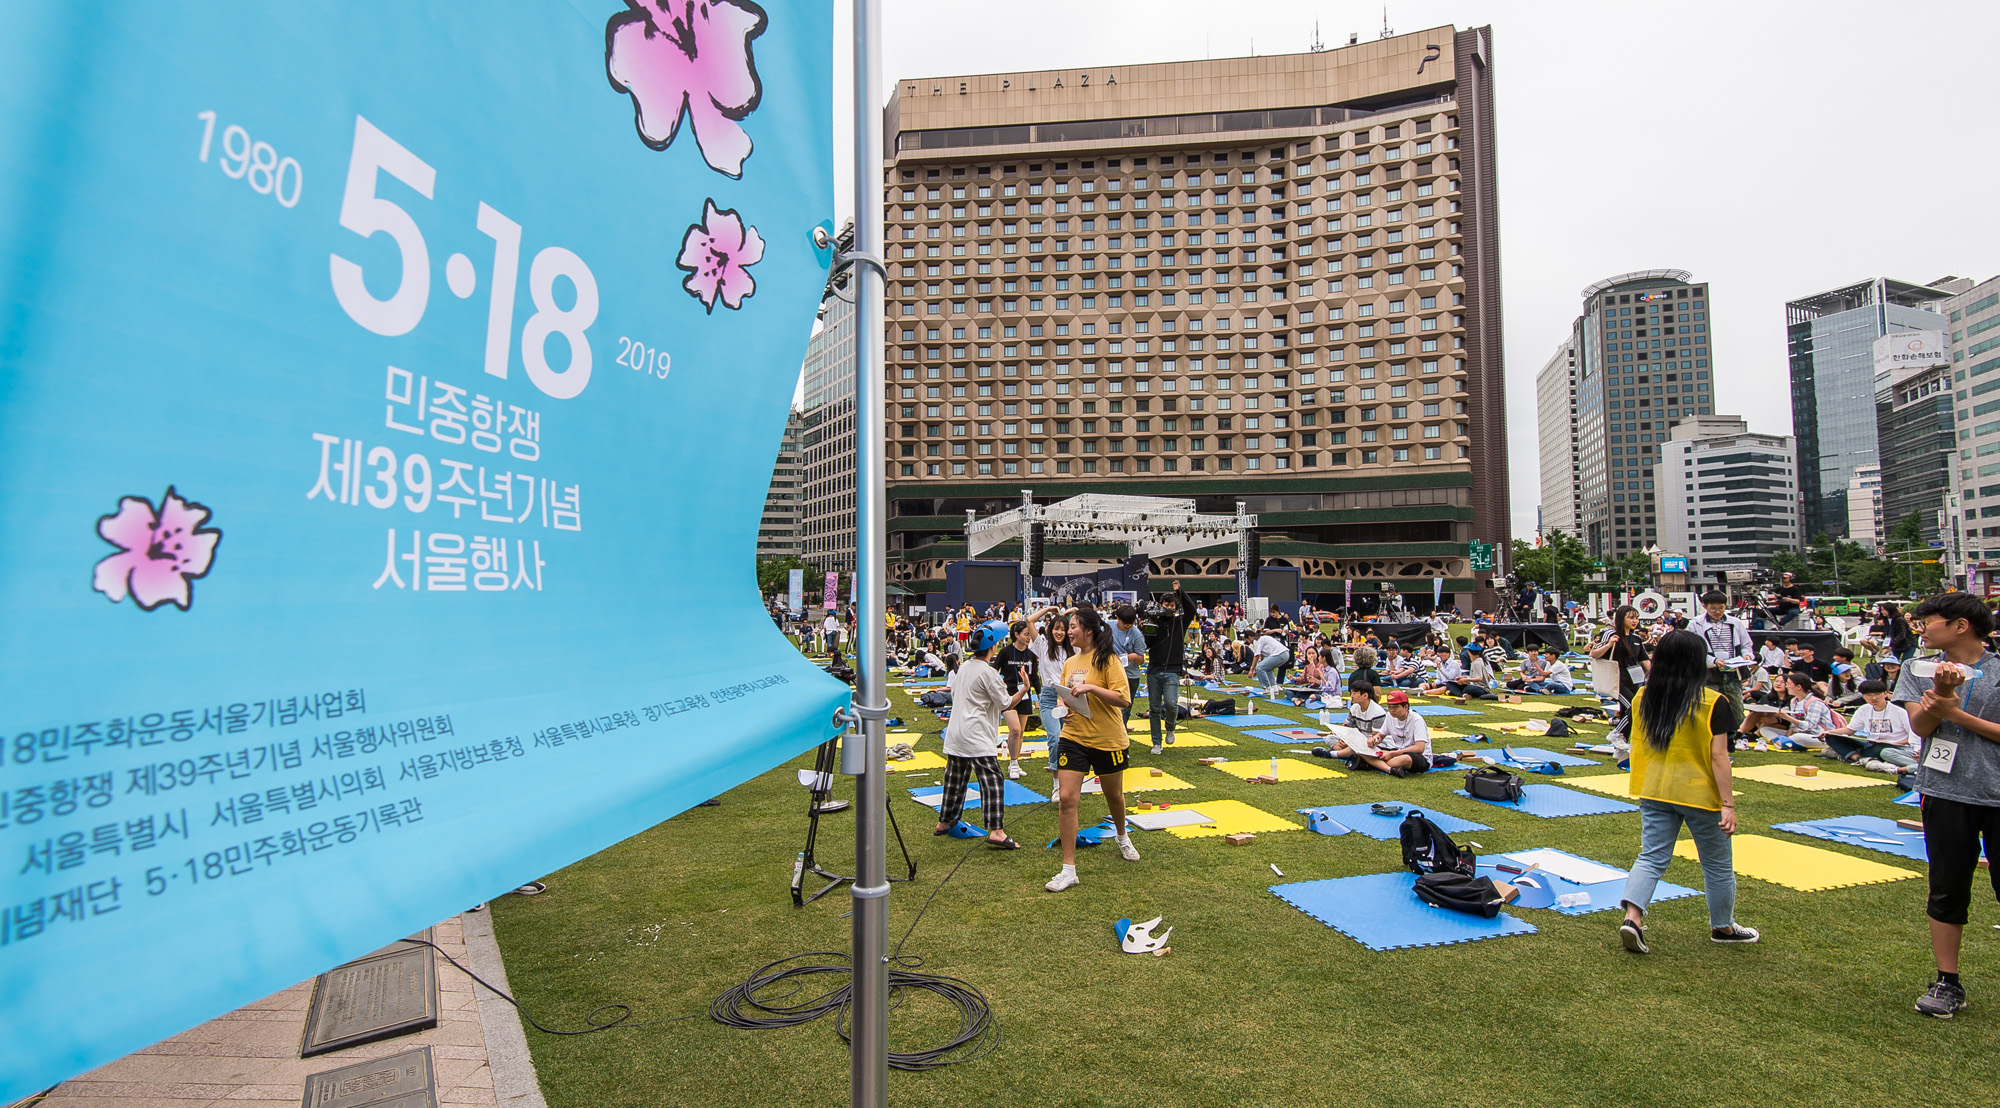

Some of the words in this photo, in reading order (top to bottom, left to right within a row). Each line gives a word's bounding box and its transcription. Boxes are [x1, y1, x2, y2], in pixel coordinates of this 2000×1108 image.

[907, 82, 967, 98] THE
[1002, 73, 1118, 92] PLAZA
[197, 110, 303, 208] 1980
[329, 113, 600, 400] 5·18
[615, 336, 672, 380] 2019
[385, 365, 541, 462] 민중항쟁
[306, 432, 582, 531] 제39주년기념
[372, 528, 545, 591] 서울행사
[20, 807, 190, 877] 서울특별시
[210, 765, 387, 827] 서울특별시의회
[398, 735, 525, 782] 서울지방보훈청
[533, 709, 641, 749] 서울특별시교육청
[641, 694, 711, 722] 경기도교육청
[709, 673, 790, 704] 인천광역시교육청
[125, 739, 303, 796] 제39주년기념
[310, 714, 455, 759] 서울행사위원회
[1111, 750, 1124, 766] 18
[1931, 747, 1951, 761] 32
[146, 796, 425, 896] 5·18민주화운동기록관
